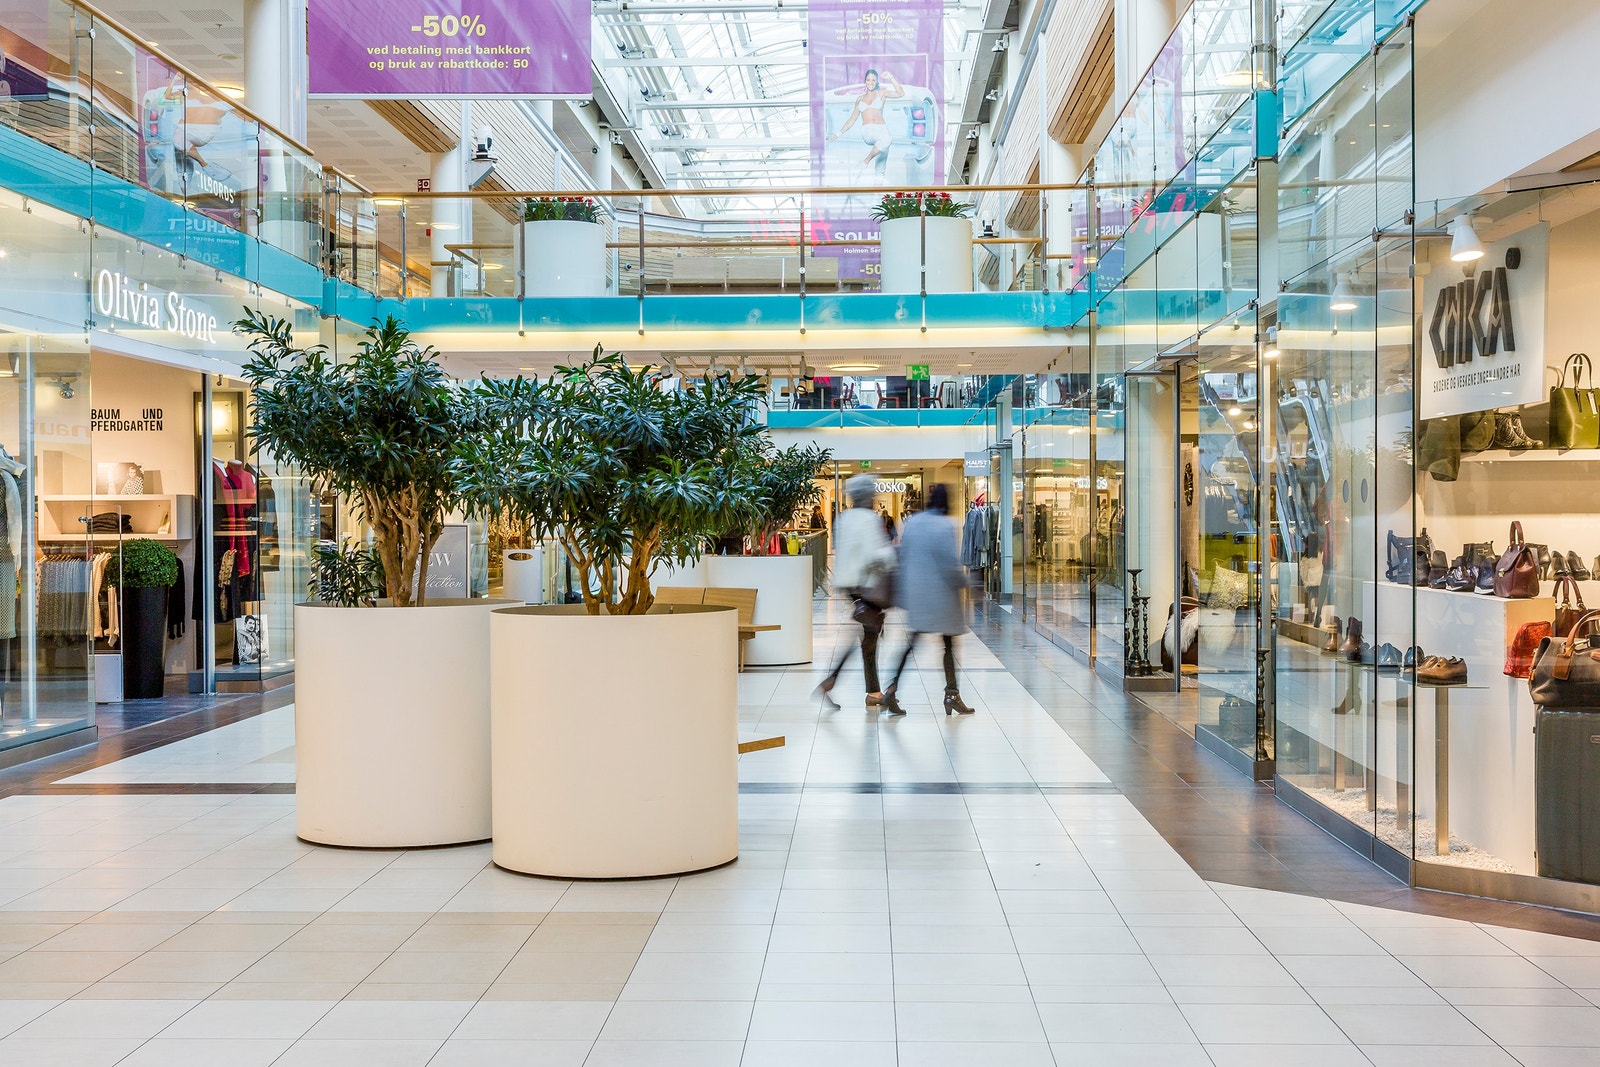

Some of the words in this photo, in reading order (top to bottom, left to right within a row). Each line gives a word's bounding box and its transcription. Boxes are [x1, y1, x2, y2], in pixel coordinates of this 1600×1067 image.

[856, 13, 893, 24] -50%
[411, 14, 487, 37] -50%
[367, 45, 389, 55] ved
[392, 45, 442, 57] betaling
[446, 45, 472, 55] med
[475, 45, 531, 55] bankkort
[369, 60, 385, 71] og
[388, 59, 416, 69] bruk
[420, 60, 434, 69] av
[438, 59, 509, 69] rabattkode:
[513, 59, 529, 69] 50
[834, 231, 881, 241] SOLH
[98, 269, 160, 329] Olivia
[167, 291, 217, 344] Stone
[90, 409, 120, 420] BAUM
[142, 408, 163, 420] UND
[90, 420, 163, 432] PFERDGARTEN
